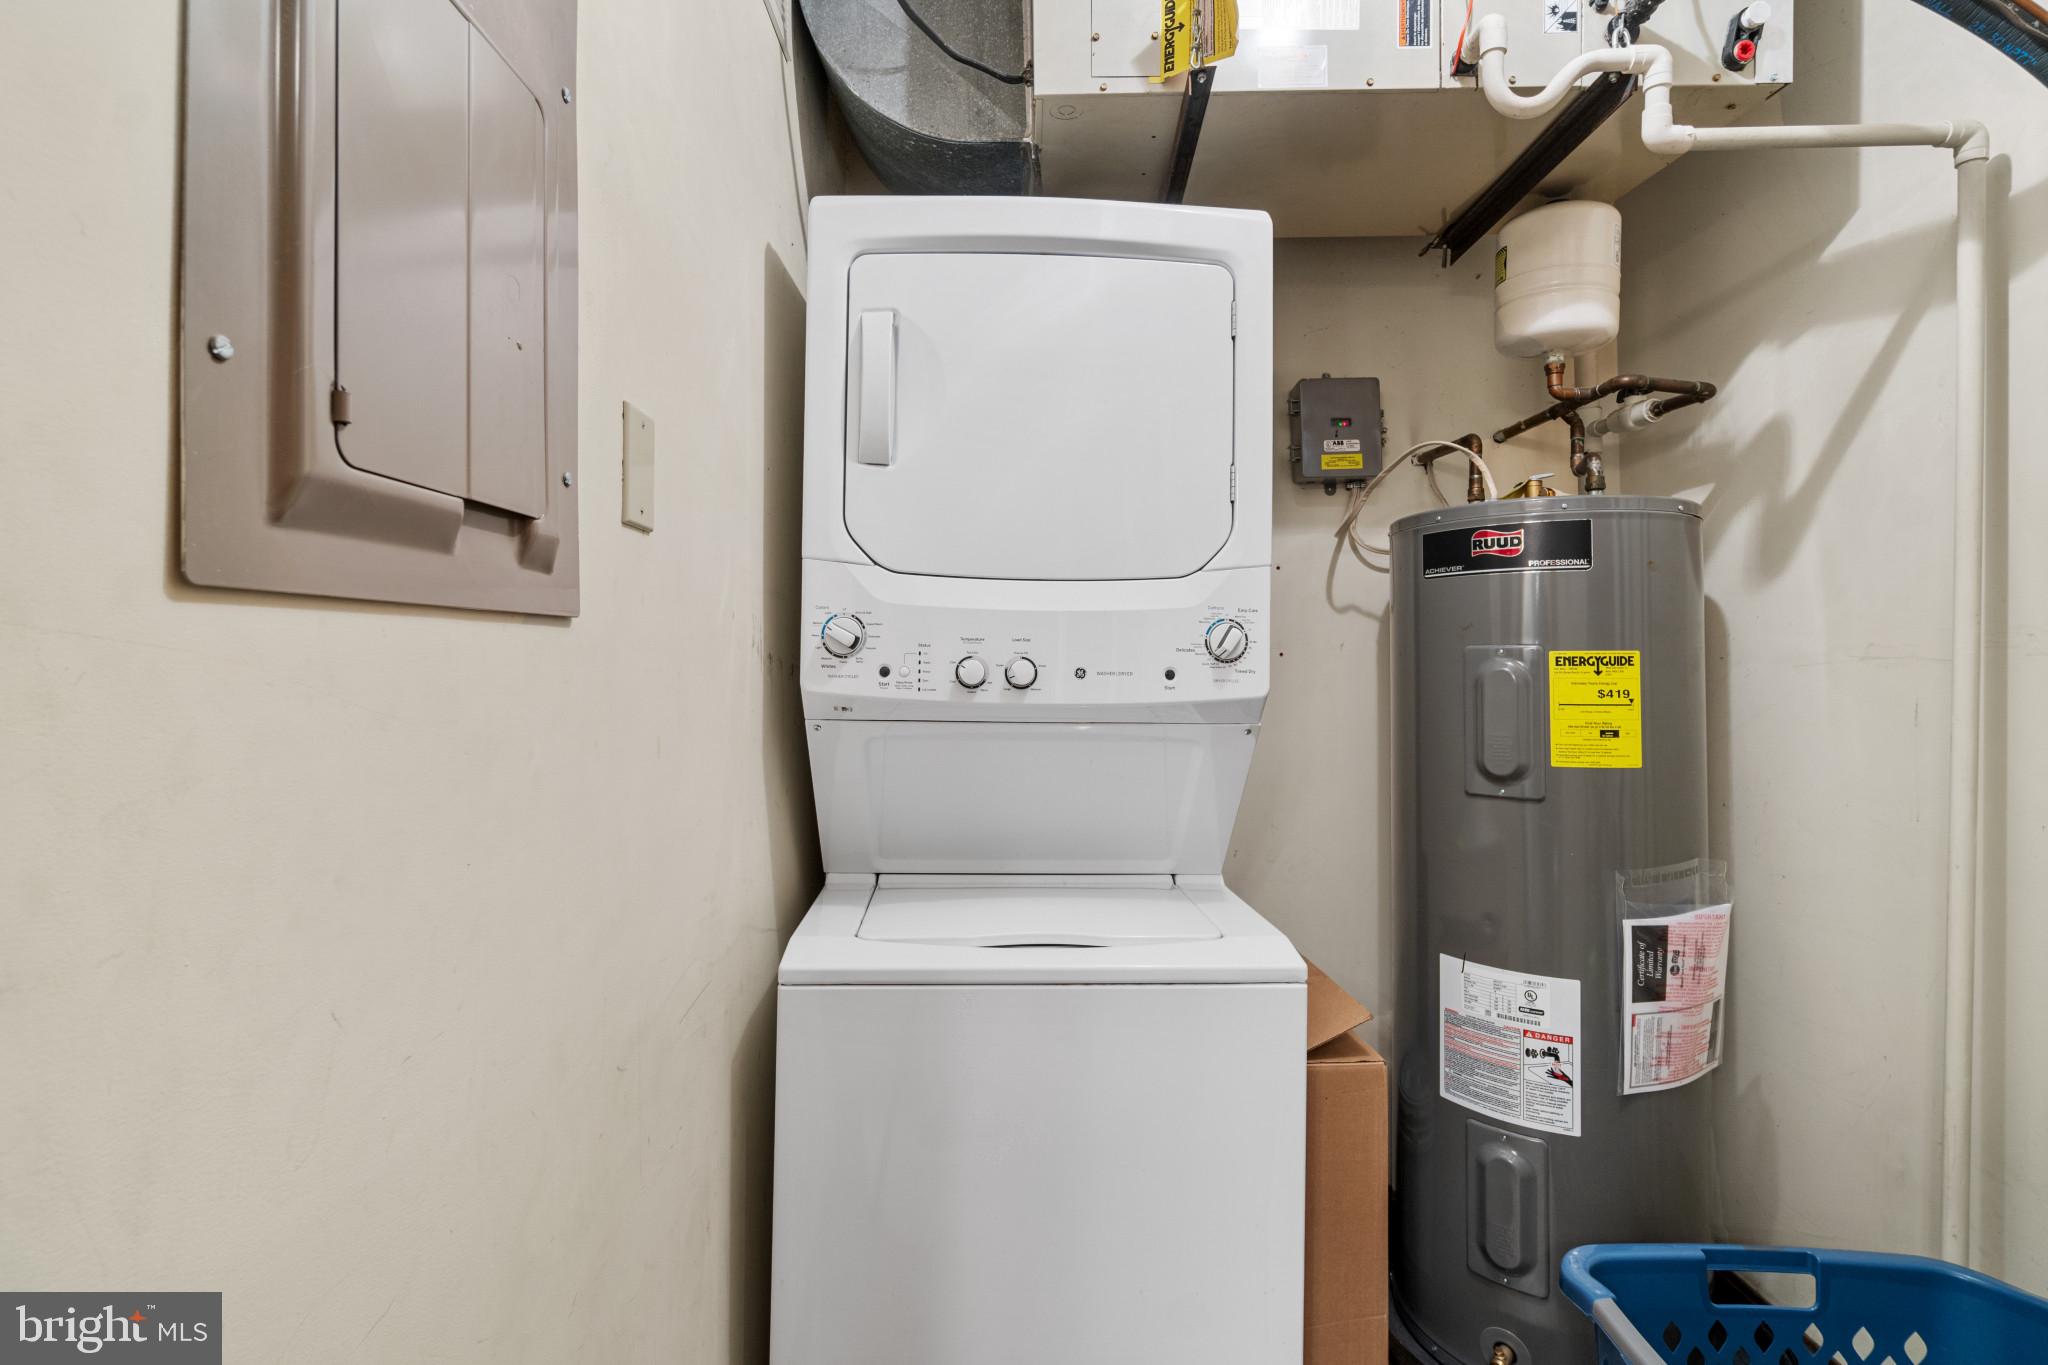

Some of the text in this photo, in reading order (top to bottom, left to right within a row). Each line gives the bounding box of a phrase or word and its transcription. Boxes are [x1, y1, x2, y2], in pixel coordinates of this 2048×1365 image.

[1164, 0, 1178, 73] ENERGYGUID
[1472, 536, 1522, 551] RUUD
[1425, 565, 1464, 575] ACHIEVER
[1527, 559, 1590, 567] PROFESSIONAL
[1555, 655, 1635, 671] ENERGYGUIDE
[1597, 689, 1630, 699] $419
[1637, 951, 1646, 987] Certificate
[1646, 950, 1654, 977] Limited
[1655, 947, 1664, 979] Warranty
[1535, 1032, 1571, 1044] DANGER
